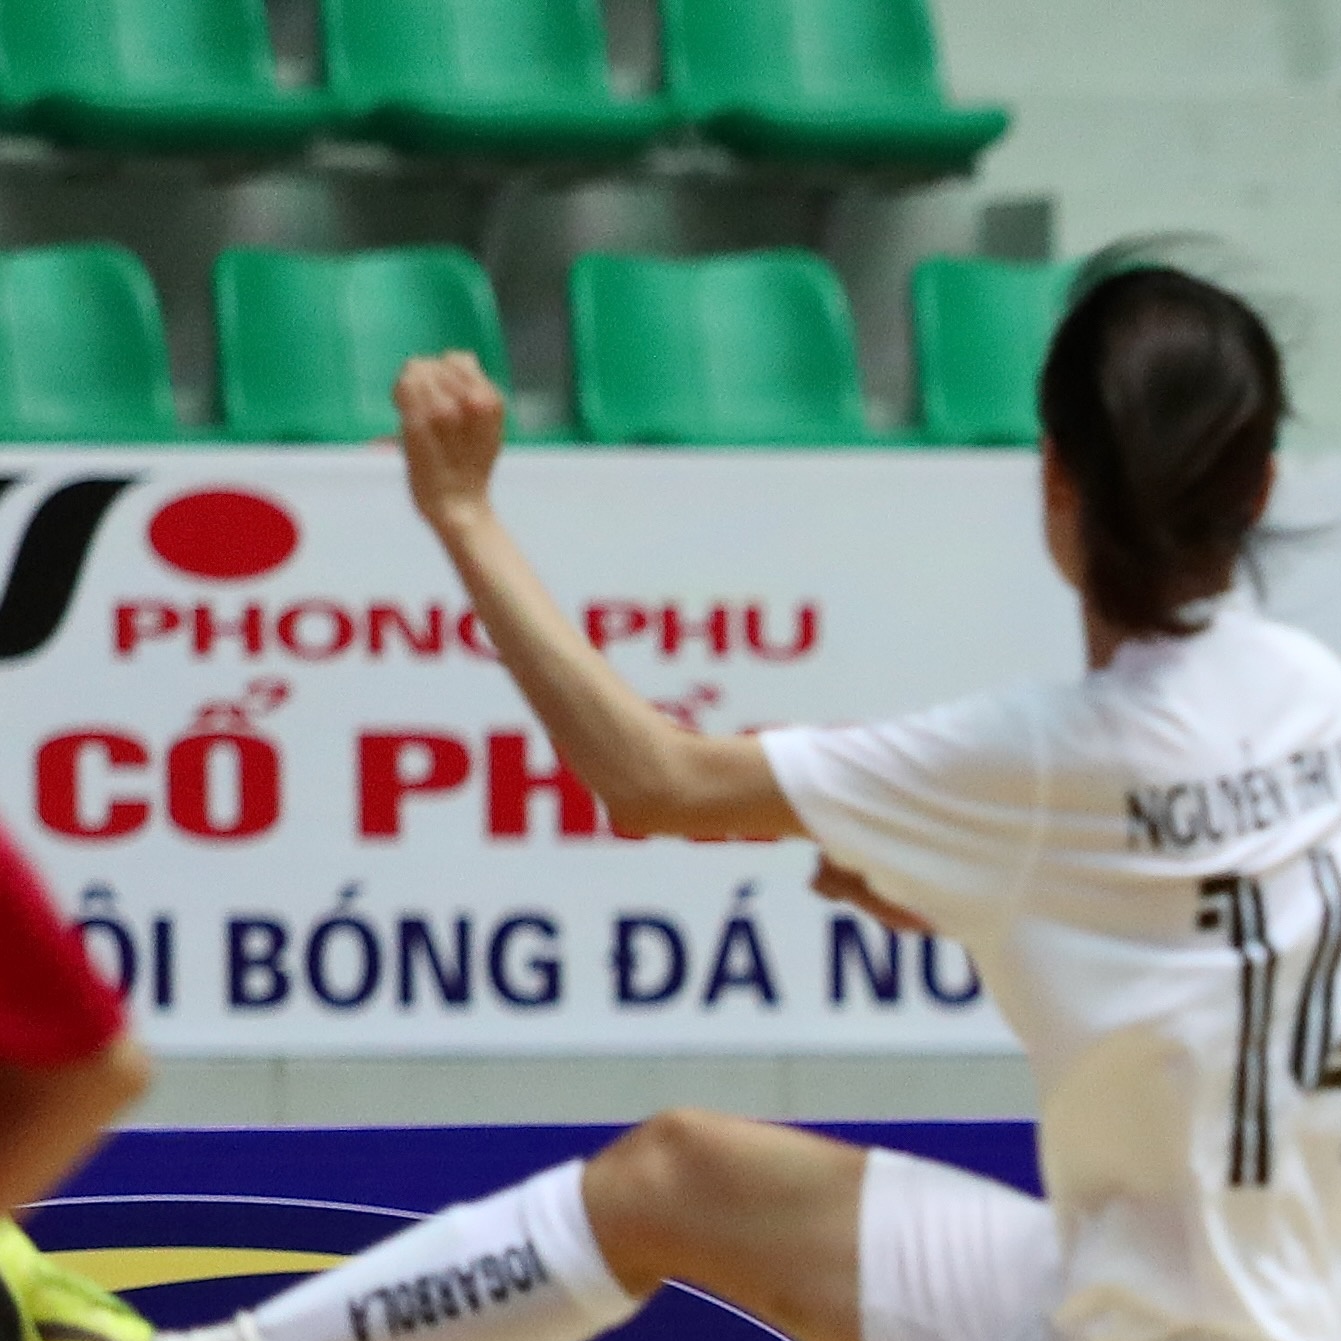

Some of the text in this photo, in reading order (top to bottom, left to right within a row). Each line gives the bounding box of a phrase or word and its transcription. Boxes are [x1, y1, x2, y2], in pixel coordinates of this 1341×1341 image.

[585, 602, 822, 662] PHU
[35, 679, 282, 846] CỔ
[226, 883, 565, 1012] BÓNG
[611, 883, 783, 1009] ĐÁ
